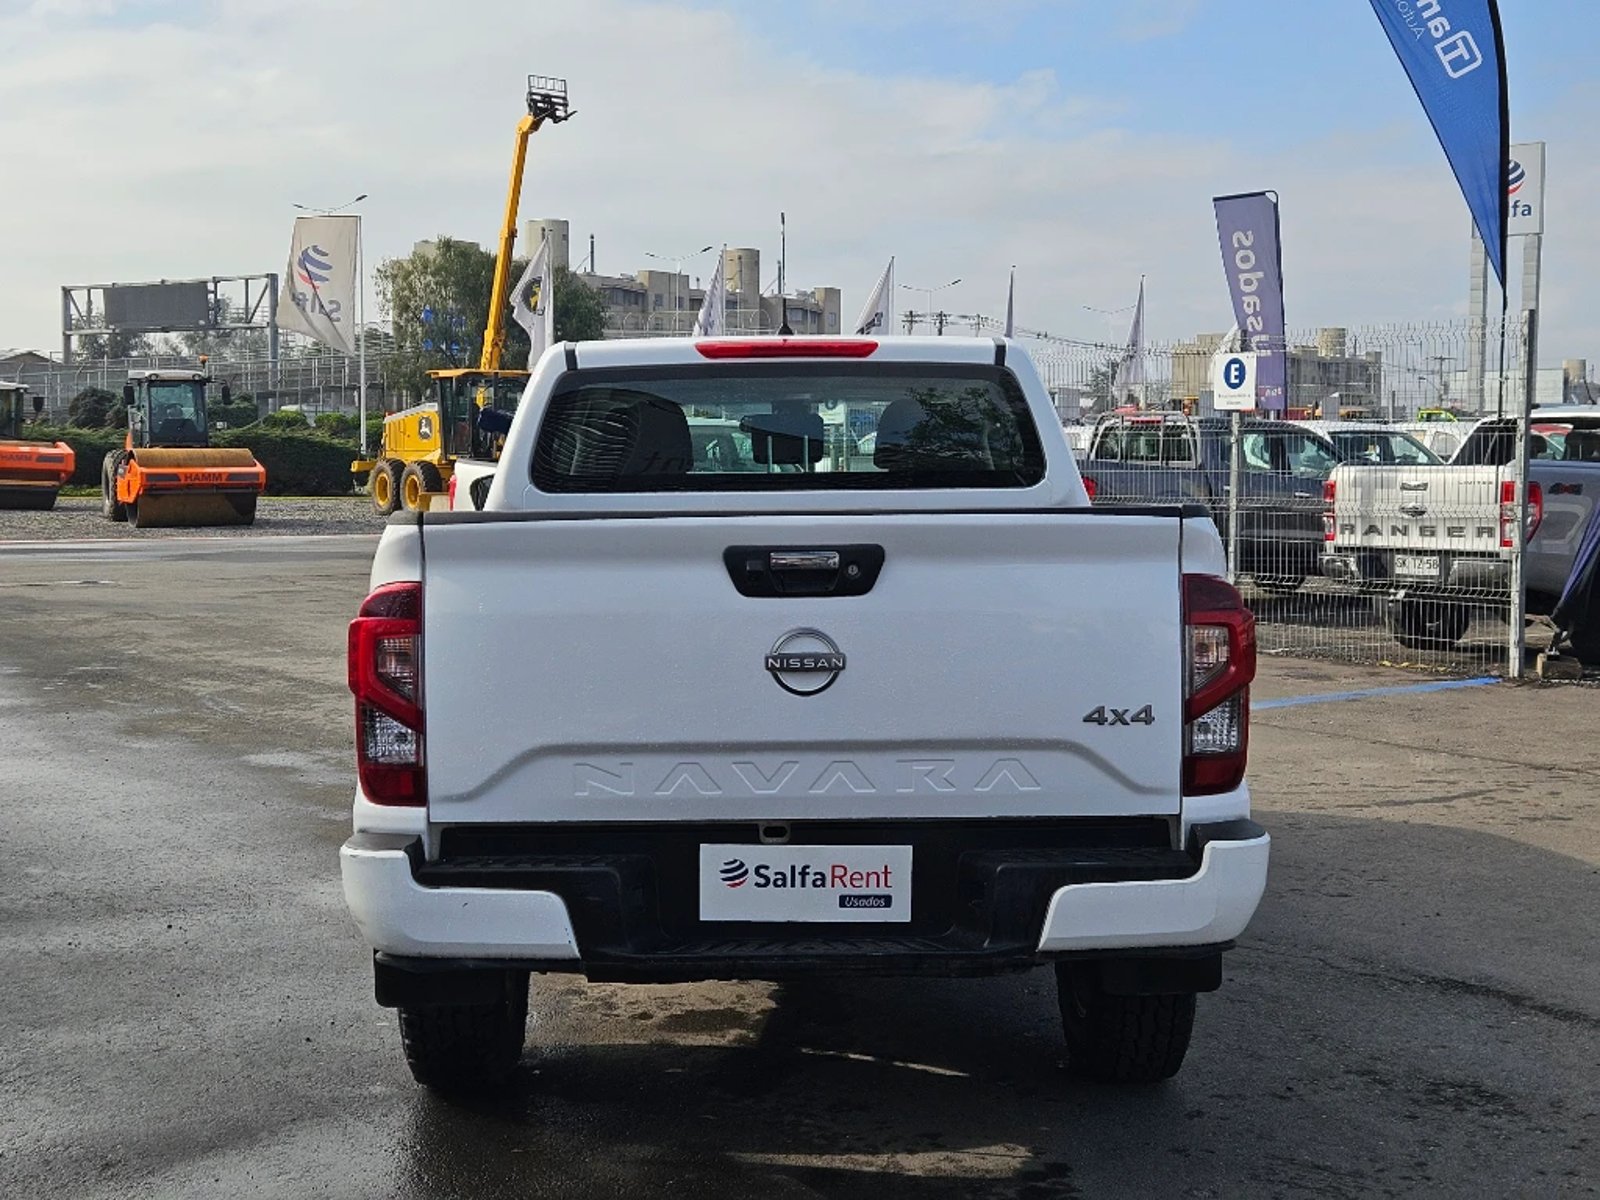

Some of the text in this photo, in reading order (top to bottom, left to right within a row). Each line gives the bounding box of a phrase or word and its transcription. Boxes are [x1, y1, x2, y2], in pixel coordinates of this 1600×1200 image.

[1229, 363, 1241, 384] E
[184, 473, 224, 483] HAMM
[1339, 523, 1496, 539] RANGER
[767, 658, 843, 669] NISSAN
[1082, 704, 1156, 726] 4x4
[573, 757, 1042, 796] NAVARA
[844, 896, 886, 908] Usados
